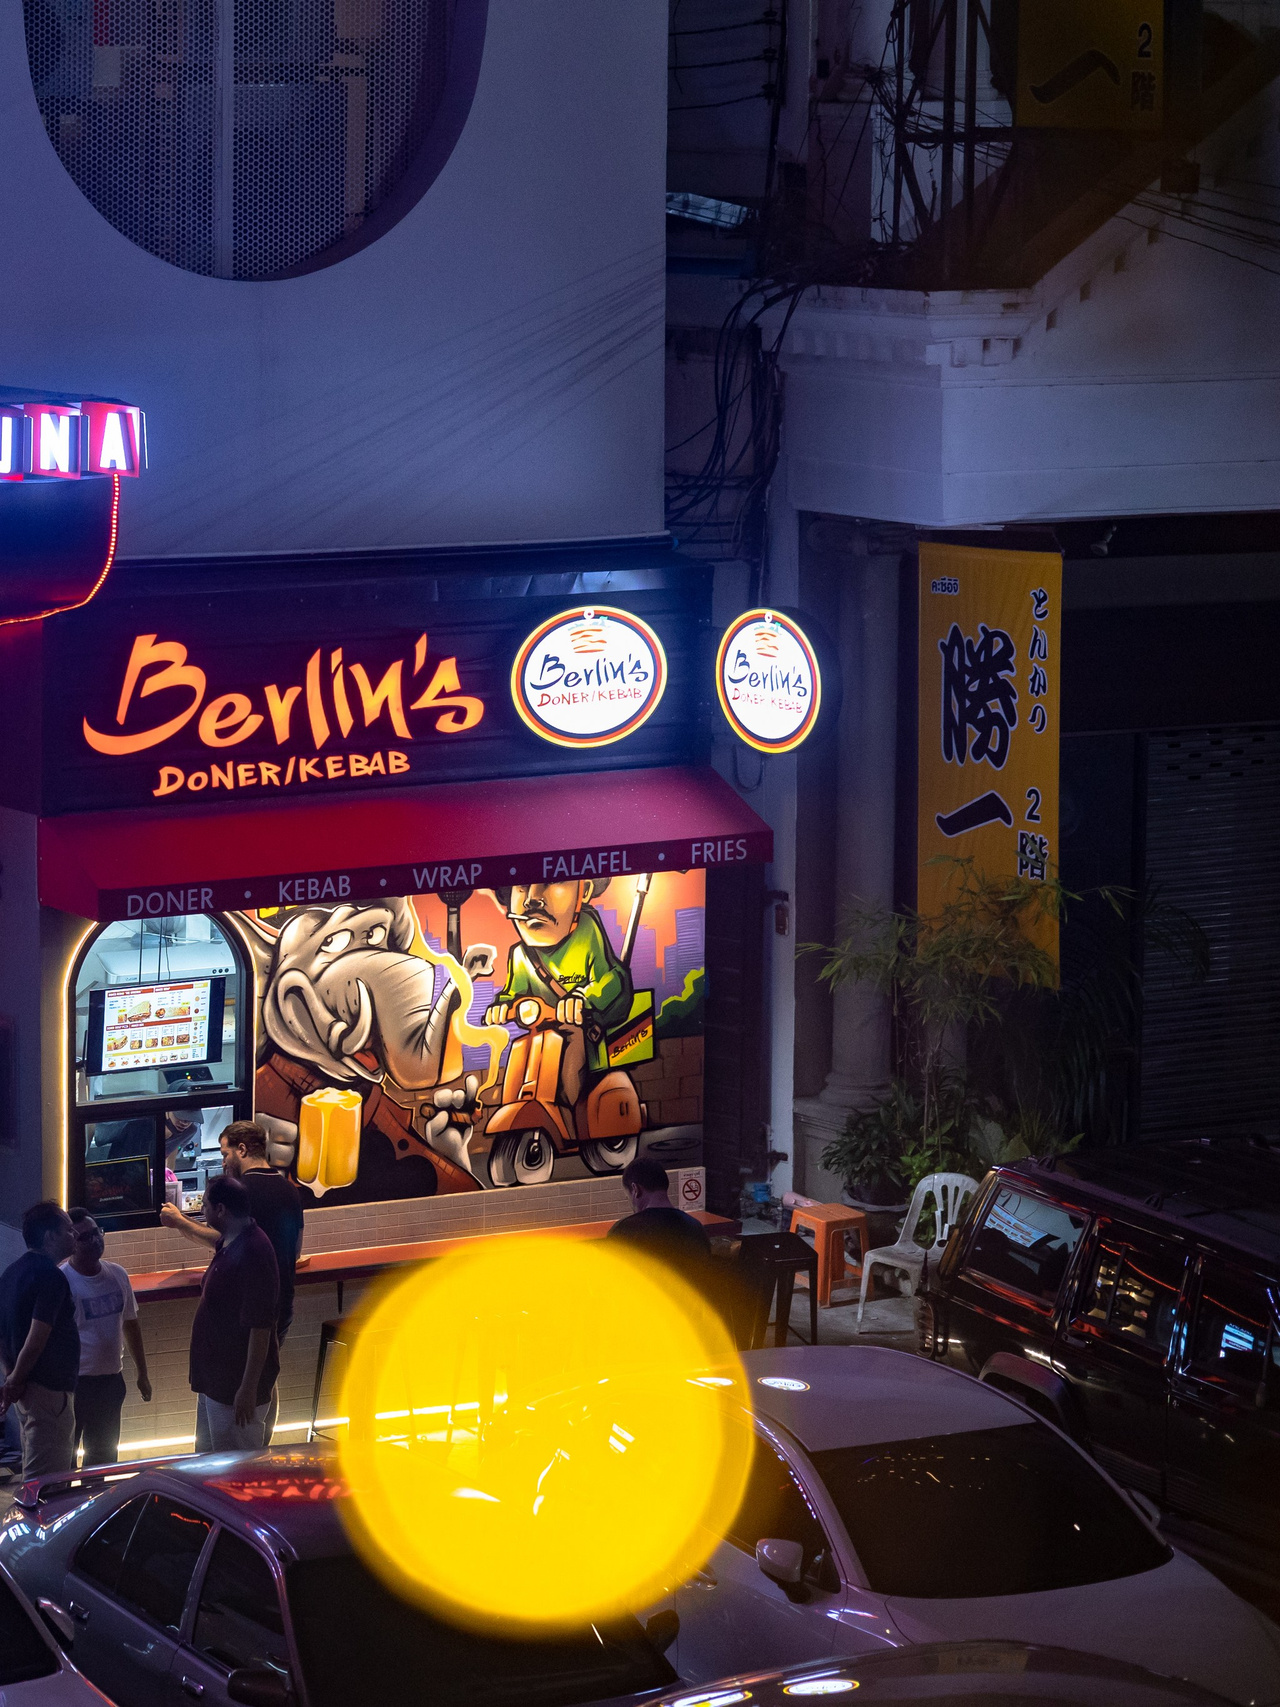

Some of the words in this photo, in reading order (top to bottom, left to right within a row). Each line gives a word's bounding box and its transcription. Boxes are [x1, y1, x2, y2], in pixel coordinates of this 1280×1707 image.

[83, 632, 484, 755] Berlin's
[529, 653, 649, 691] Berlin's
[728, 649, 808, 698] Berlin's
[126, 887, 214, 917] DONER
[278, 875, 352, 903] KEBAB
[413, 863, 483, 890] WRAP
[542, 850, 632, 879] FALAFEL
[690, 838, 748, 865] FRIES
